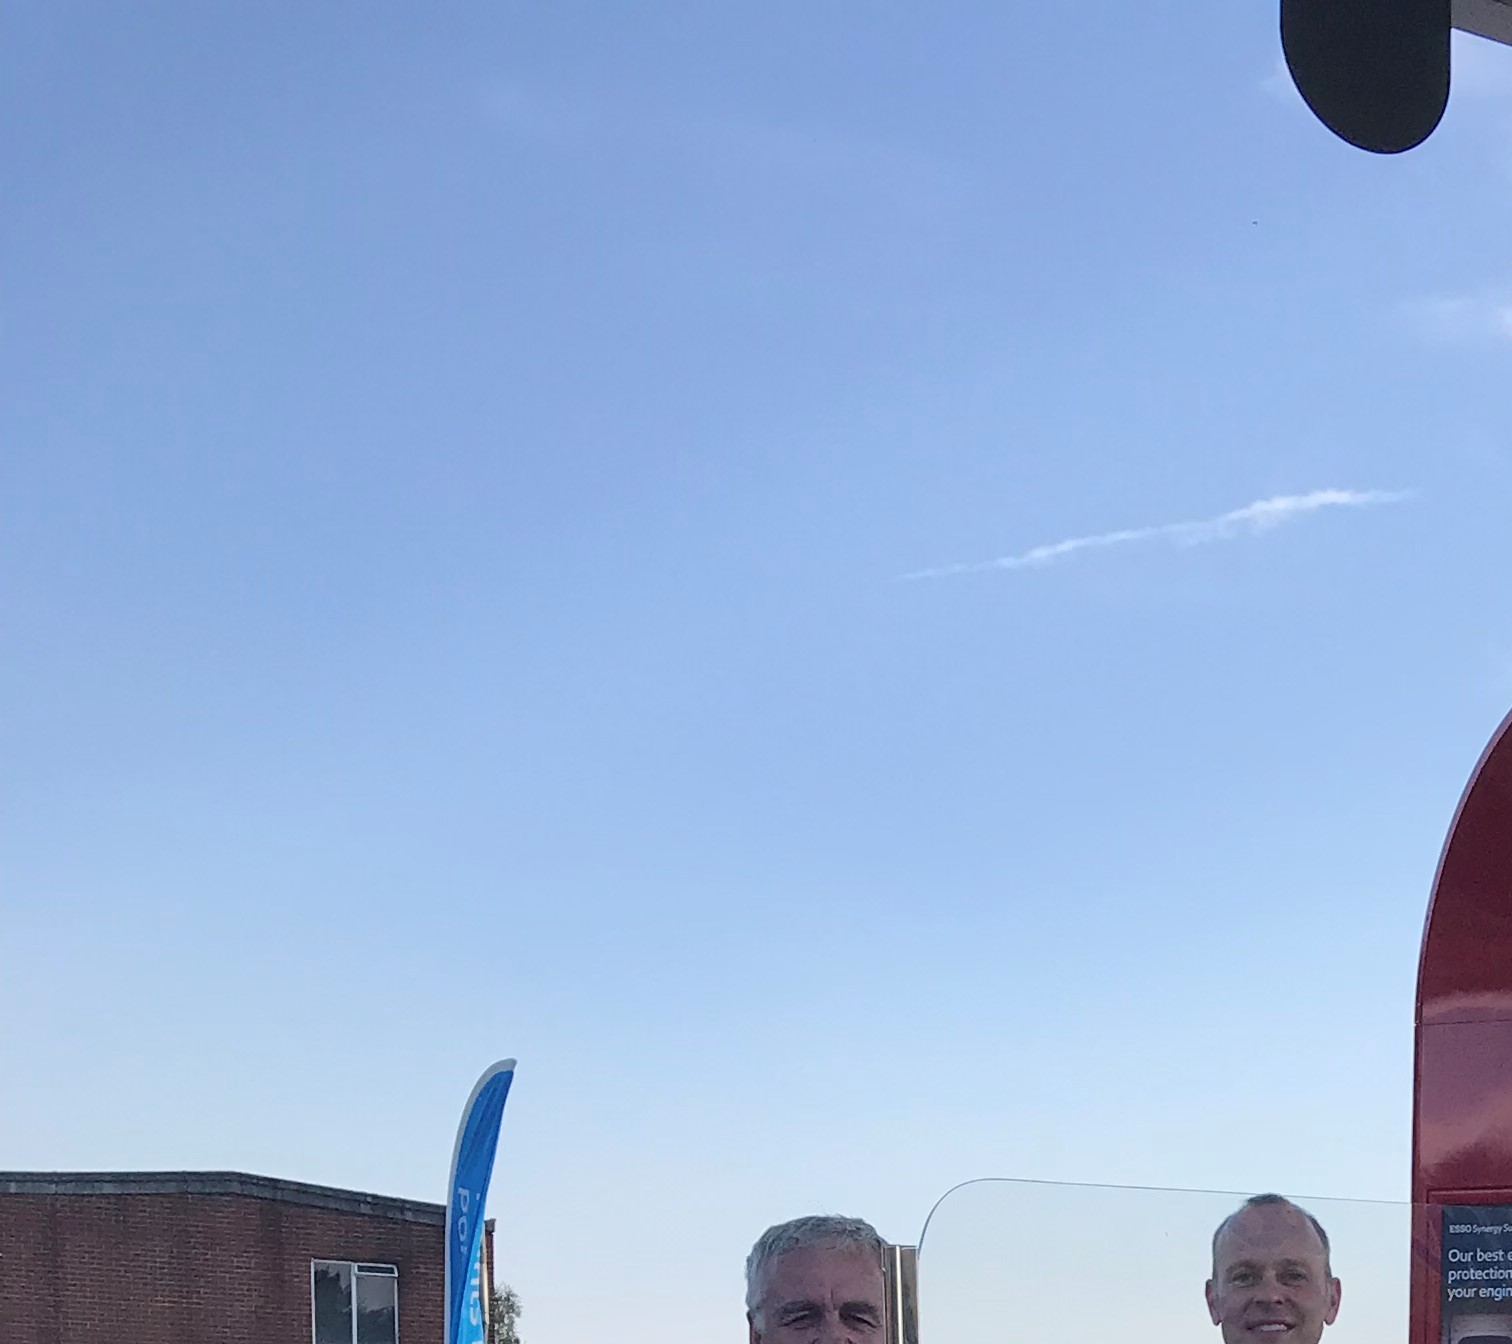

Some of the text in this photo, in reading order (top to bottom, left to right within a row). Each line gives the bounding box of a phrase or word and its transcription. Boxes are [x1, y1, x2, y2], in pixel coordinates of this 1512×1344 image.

[1449, 1223, 1472, 1234] ESSO
[1472, 1223, 1502, 1235] Synergy
[1447, 1248, 1473, 1263] Our
[1476, 1248, 1504, 1263] best
[1447, 1285, 1476, 1301] your
